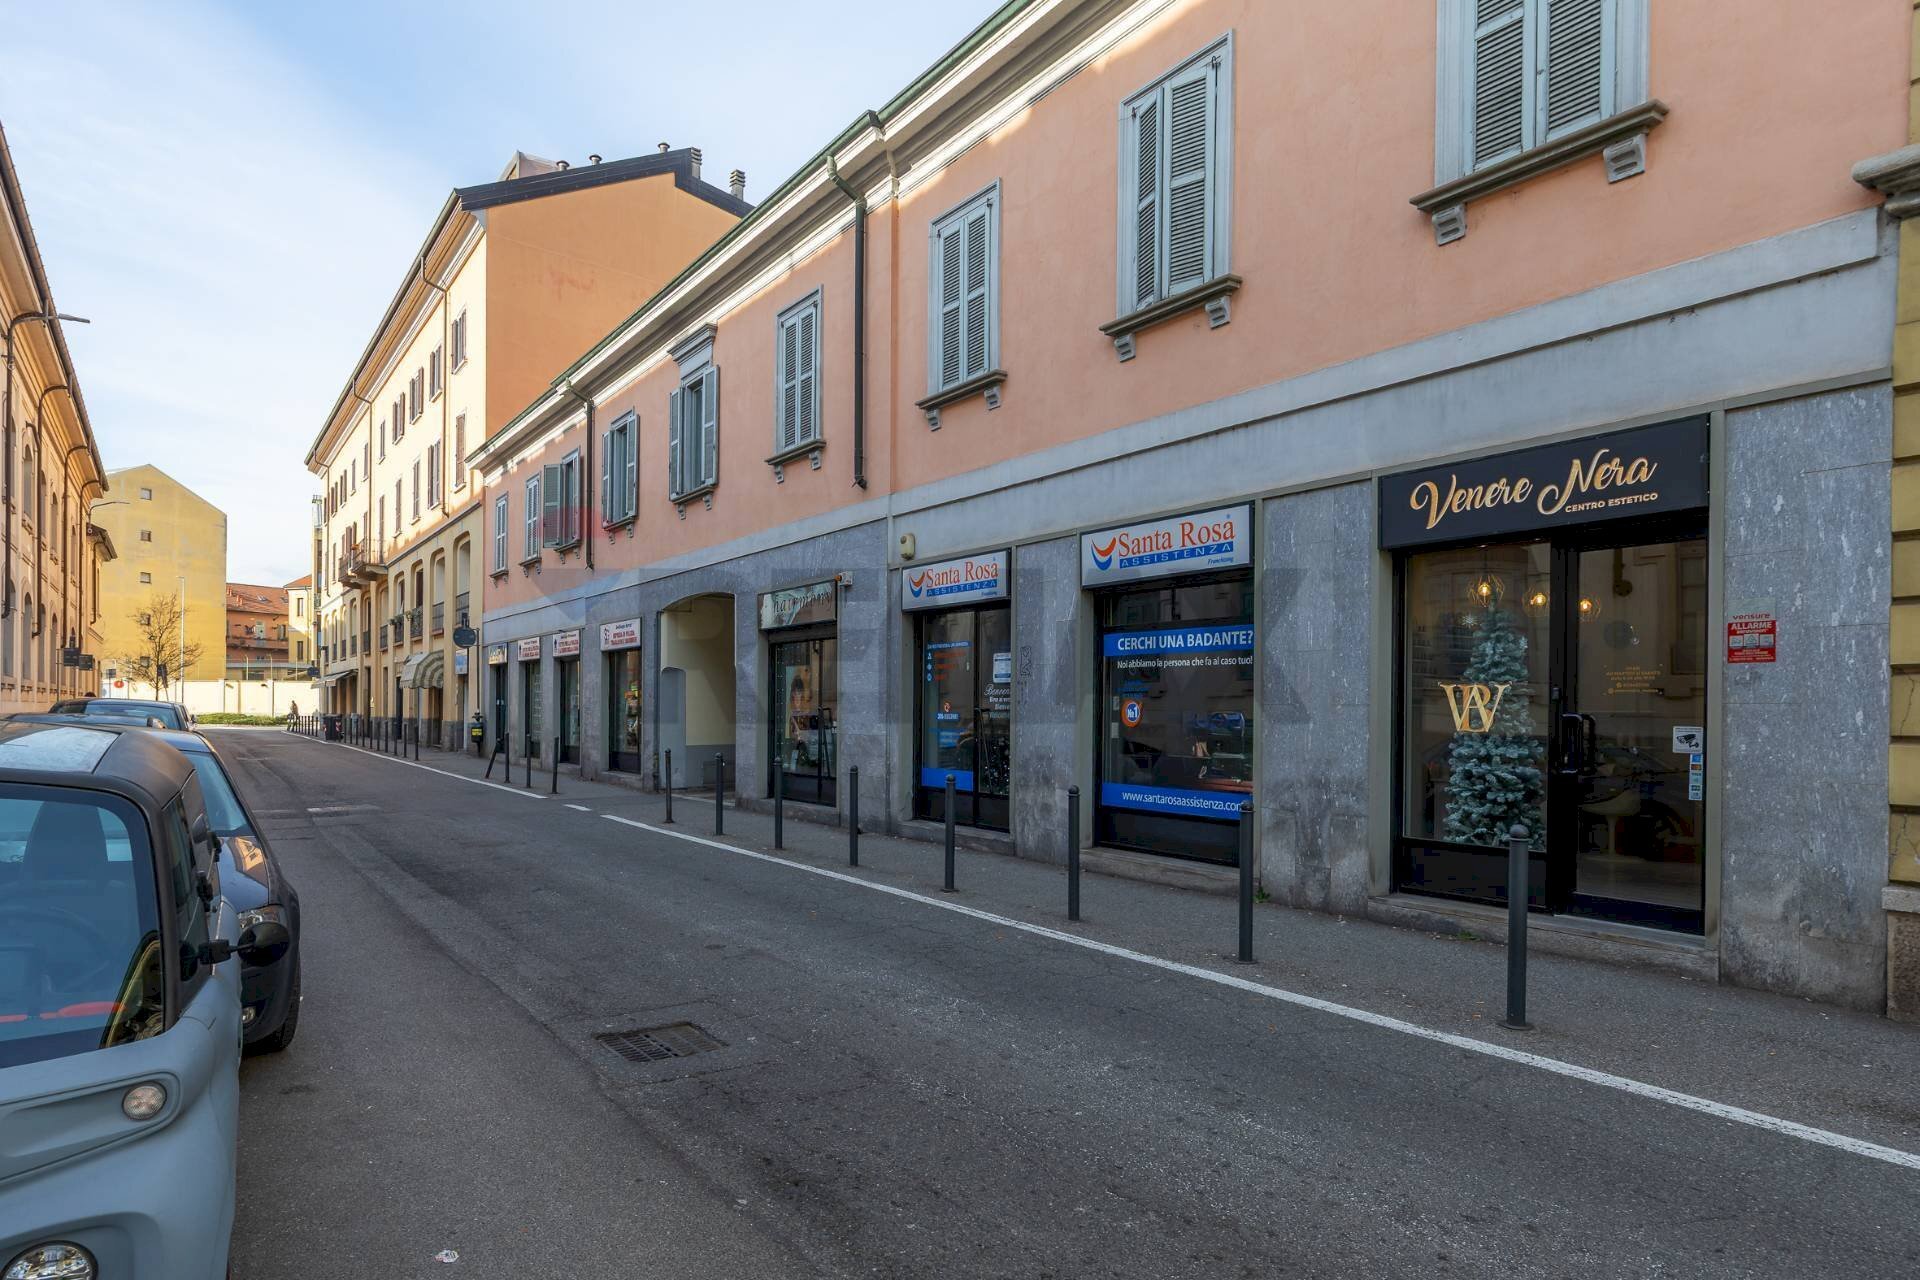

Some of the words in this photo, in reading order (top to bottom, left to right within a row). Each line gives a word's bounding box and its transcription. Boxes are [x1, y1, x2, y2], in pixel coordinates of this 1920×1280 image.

[1410, 474, 1533, 530] Venere
[1537, 448, 1658, 515] Nera
[1565, 501, 1606, 513] CENTRO
[1607, 493, 1659, 507] ESTETICO
[1118, 530, 1173, 557] Santa
[1179, 520, 1236, 548] Rosa
[1121, 543, 1232, 568] ASSISTENZA
[926, 567, 960, 588] Santa
[964, 561, 999, 582] Rosa
[927, 581, 996, 596] ASSISTENZA
[1731, 621, 1773, 630] ALLARME
[1117, 636, 1156, 651] CERCHI
[1158, 635, 1185, 648] UNA
[1187, 630, 1254, 647] BADANTE?
[1117, 660, 1129, 669] Noi
[1128, 658, 1156, 668] abbiamo
[1156, 659, 1163, 667] la
[1163, 659, 1191, 669] persona
[1191, 657, 1204, 666] che
[1204, 656, 1212, 666] fa
[1212, 656, 1220, 665] al
[1220, 657, 1236, 665] caso
[1237, 655, 1253, 665] tuo!
